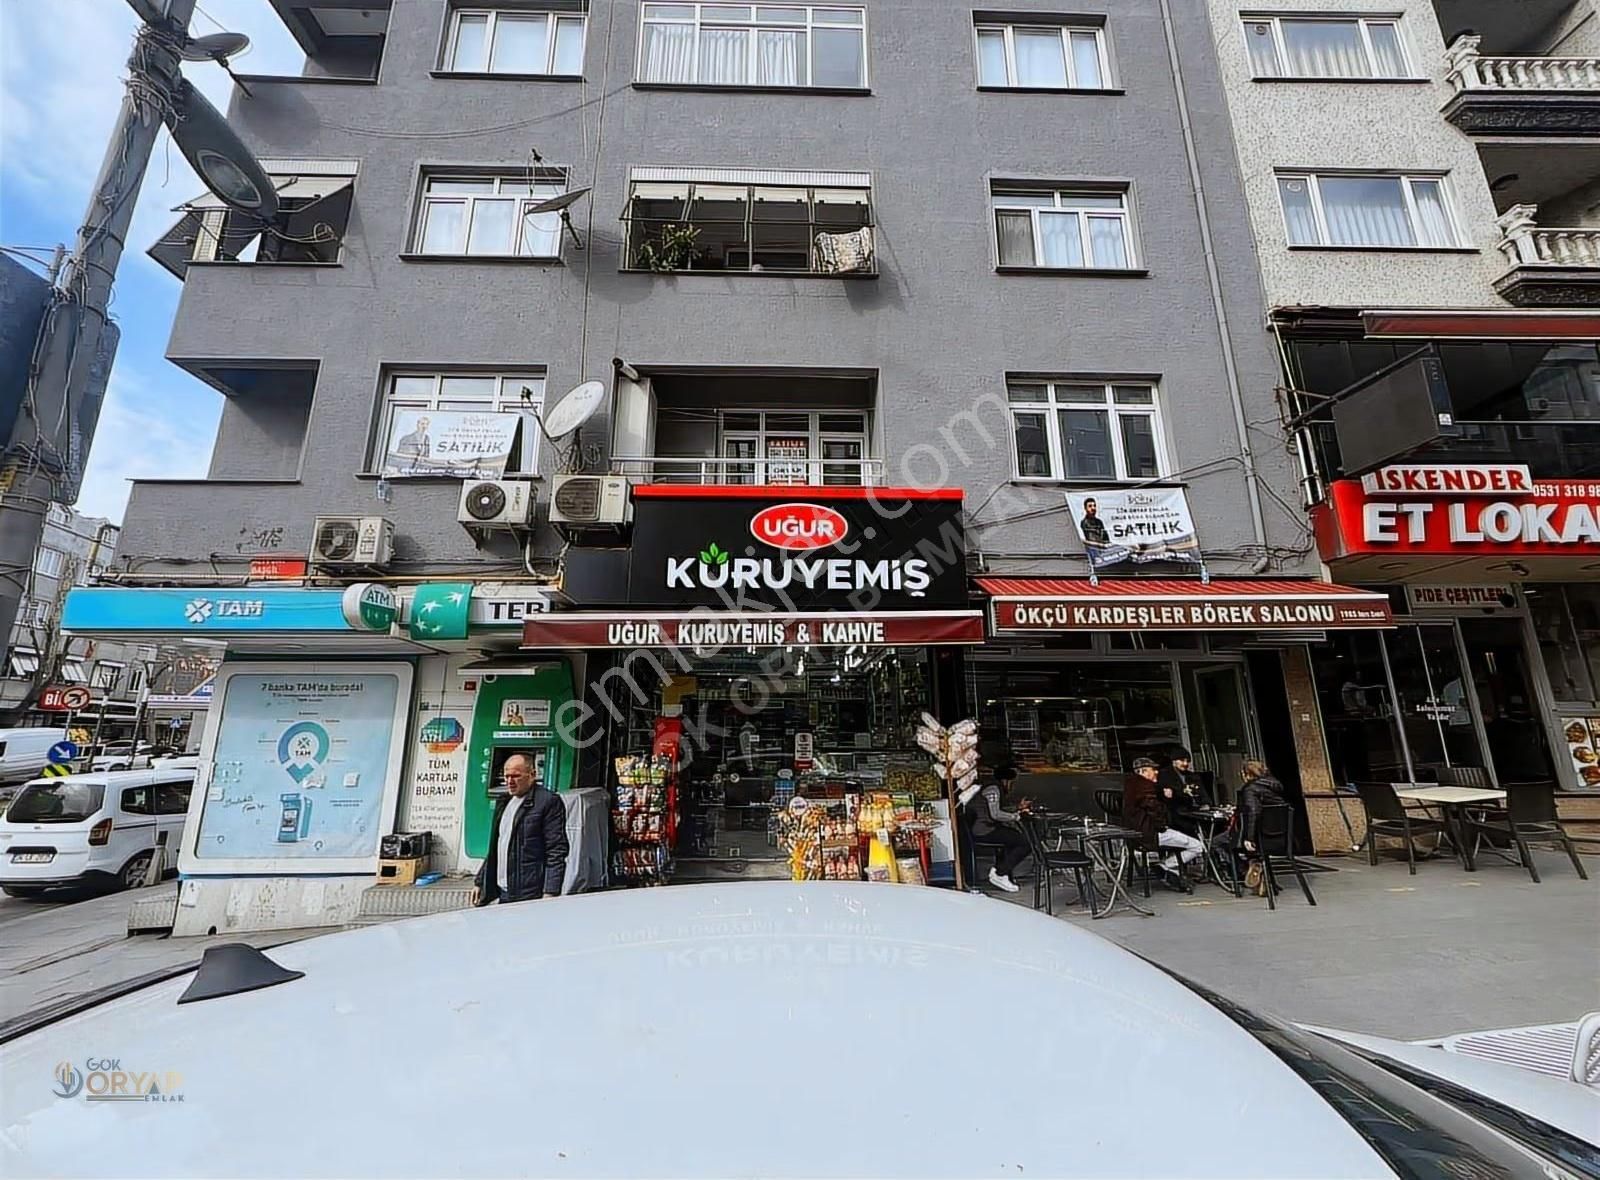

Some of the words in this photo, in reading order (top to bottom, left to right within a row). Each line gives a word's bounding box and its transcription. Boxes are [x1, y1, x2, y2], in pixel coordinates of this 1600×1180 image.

[437, 440, 506, 453] SATILIK
[1533, 485, 1560, 496] 0531
[1564, 485, 1585, 496] 318
[763, 516, 836, 538] UĞUR
[1113, 520, 1184, 538] SATILIK
[1364, 503, 1433, 543] ET
[1449, 503, 1600, 543] LOKA
[667, 557, 930, 597] KURUYEMİŞ
[367, 589, 391, 606] ATM
[217, 600, 264, 617] TAM
[489, 601, 545, 620] TEB
[1015, 604, 1068, 627] ÖKÇÜ
[1074, 605, 1186, 627] KARDEŞLER
[1191, 602, 1255, 623] BÖREK
[1260, 604, 1335, 622] SALONU
[607, 621, 661, 644] UĞUR
[678, 620, 786, 646] KURUYEMİŞ
[797, 625, 810, 643] &
[823, 622, 885, 643] KAHVE
[428, 757, 450, 769] TÜM
[416, 773, 458, 783] KARTLAR
[416, 786, 456, 796] BURAYA!
